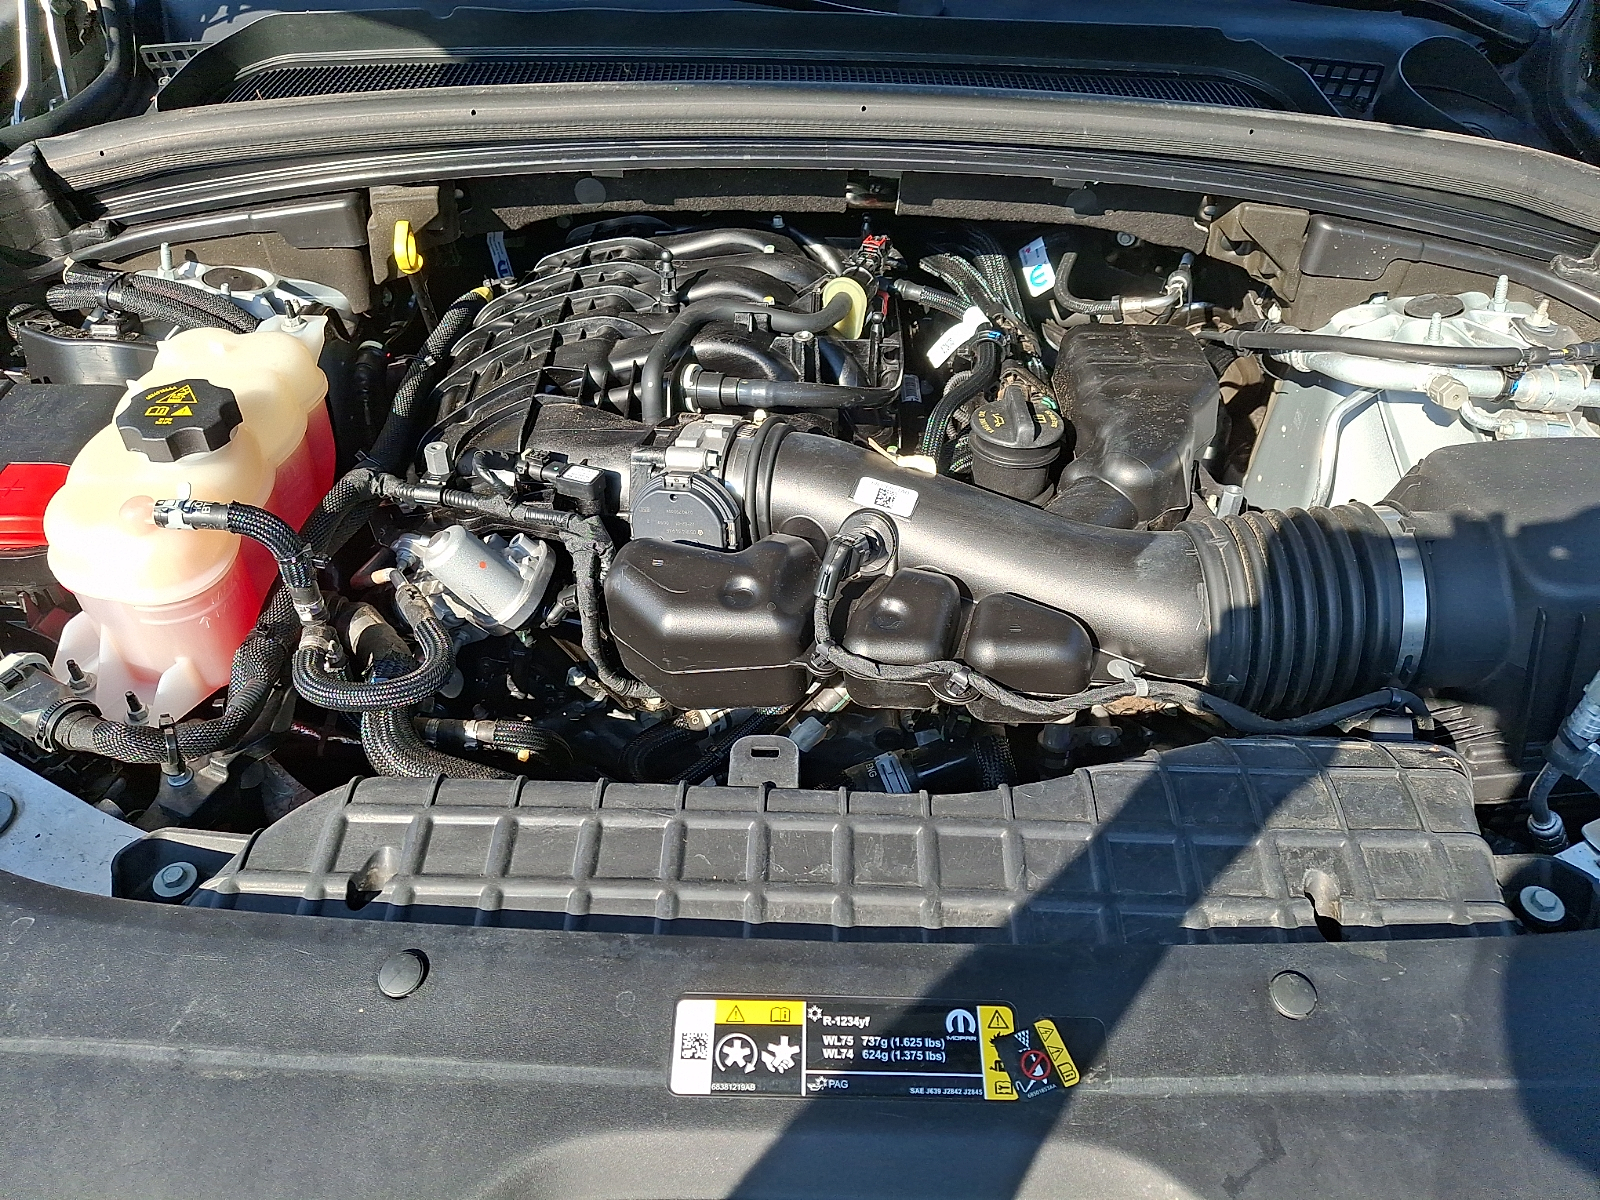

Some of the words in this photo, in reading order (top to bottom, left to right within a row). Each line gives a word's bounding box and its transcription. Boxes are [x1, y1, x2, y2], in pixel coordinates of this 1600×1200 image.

[865, 762, 878, 778] ENG
[822, 1015, 871, 1029] R-1234yf
[822, 1035, 854, 1046] WL75
[861, 1035, 888, 1049] 737g
[890, 1037, 922, 1049] (1.625
[925, 1037, 946, 1050] lbs)
[822, 1048, 855, 1059] WL74
[862, 1049, 889, 1062] 624g
[890, 1050, 923, 1062] (1.375
[925, 1051, 946, 1063] lbs)
[711, 1083, 756, 1091] 68381219AB
[828, 1079, 849, 1089] PAG
[910, 1087, 925, 1095] SAE
[926, 1087, 942, 1095] J639
